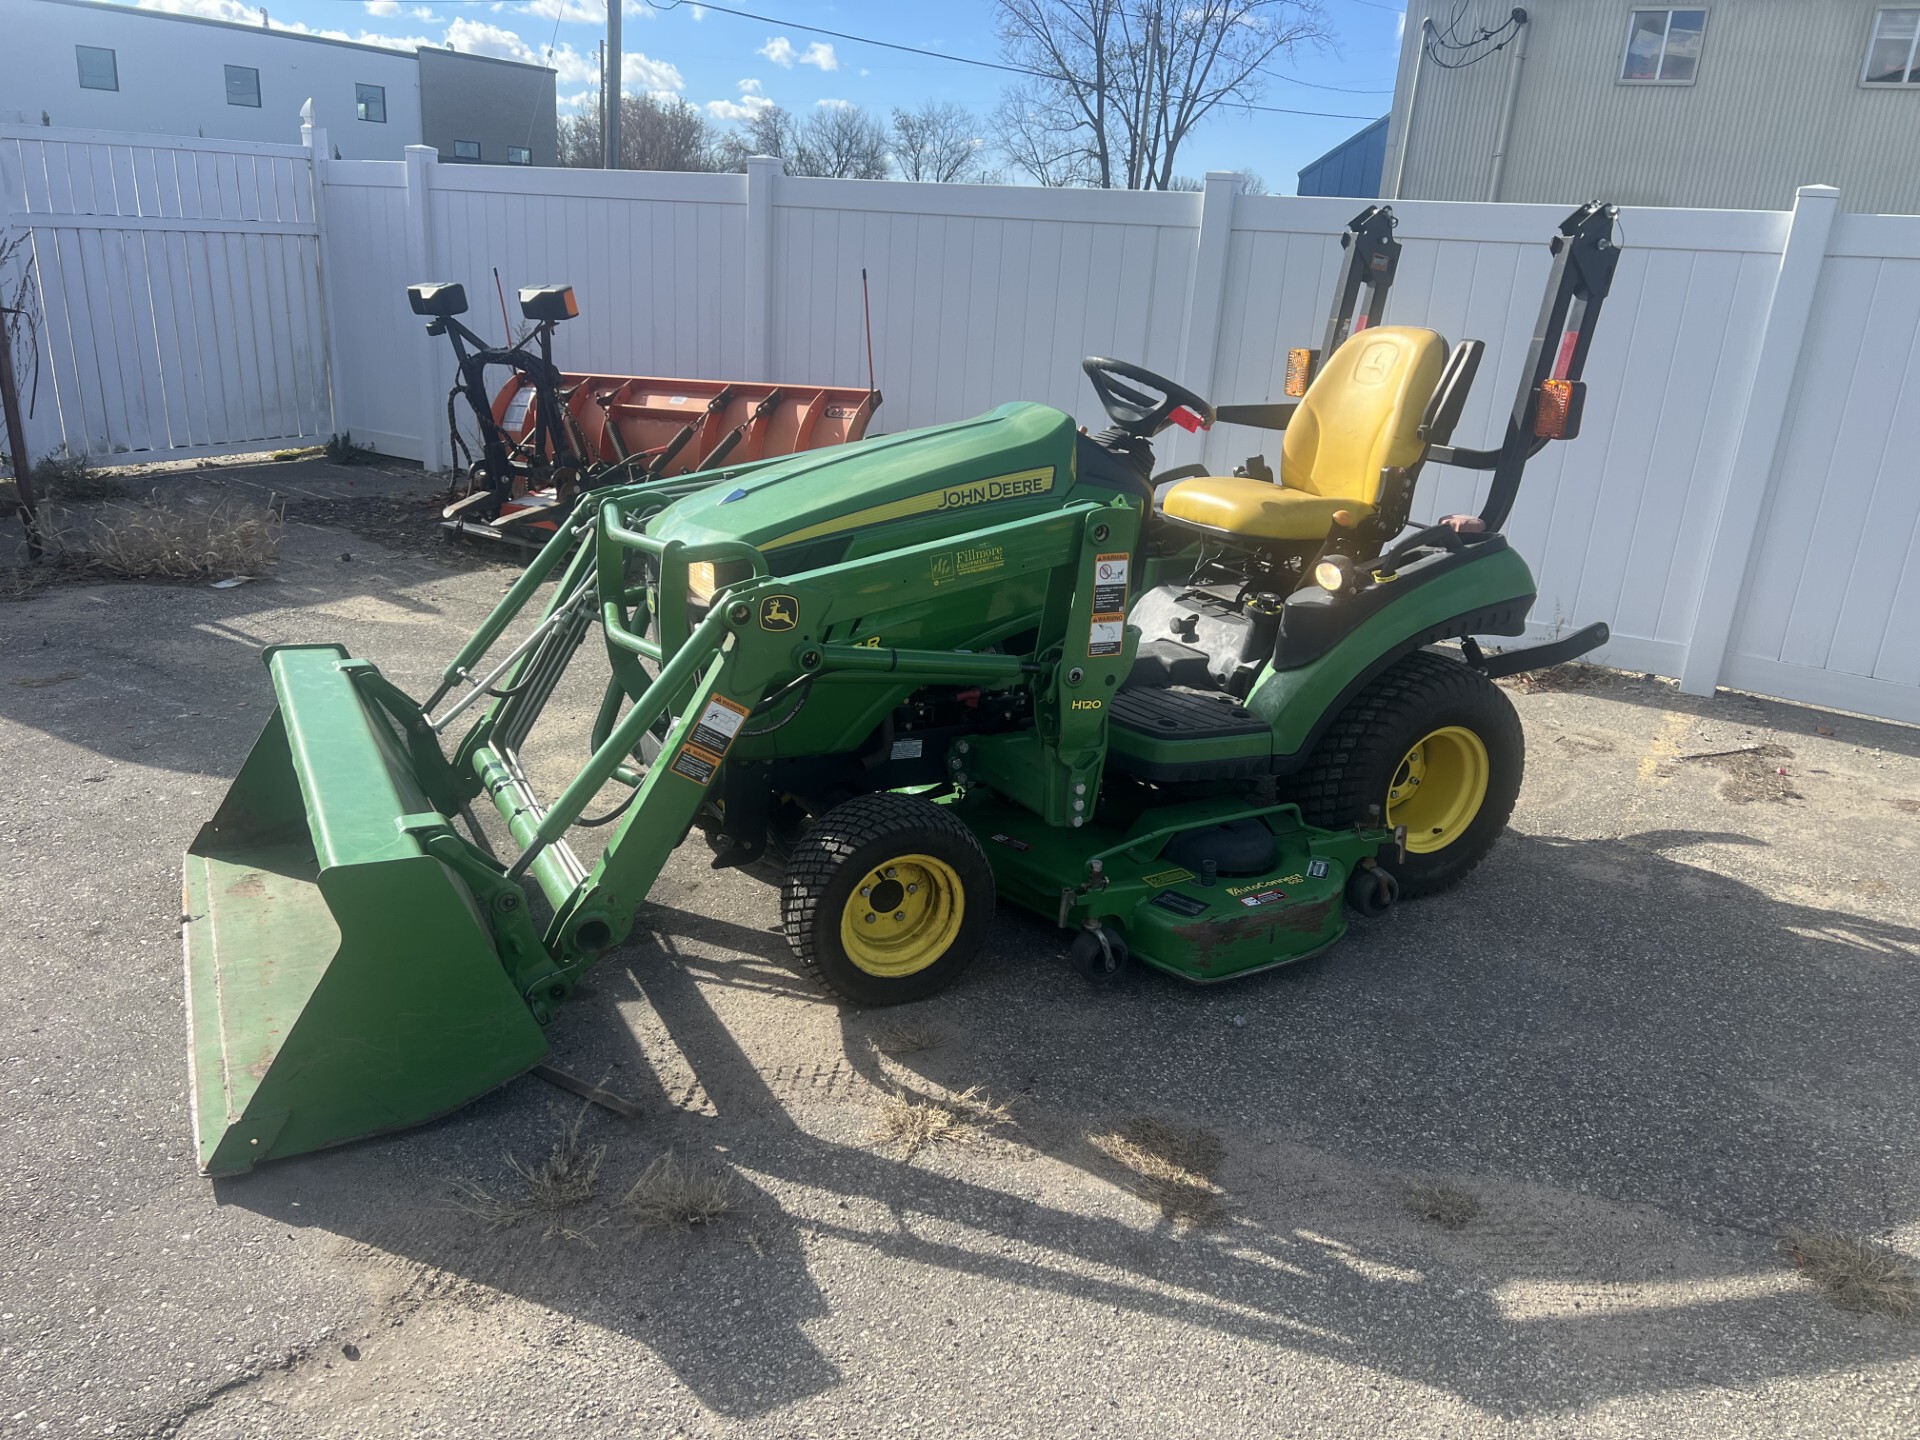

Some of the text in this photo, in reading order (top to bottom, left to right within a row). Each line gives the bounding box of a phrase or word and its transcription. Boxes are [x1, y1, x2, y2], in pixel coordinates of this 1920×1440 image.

[824, 406, 857, 419] CURT
[938, 478, 1043, 508] JOHN DEERE
[956, 546, 1003, 563] Fillmore
[722, 699, 745, 714] WARNING
[1072, 700, 1102, 709] H120
[693, 749, 716, 764] WARNING
[1232, 873, 1303, 895] AutoConnect
